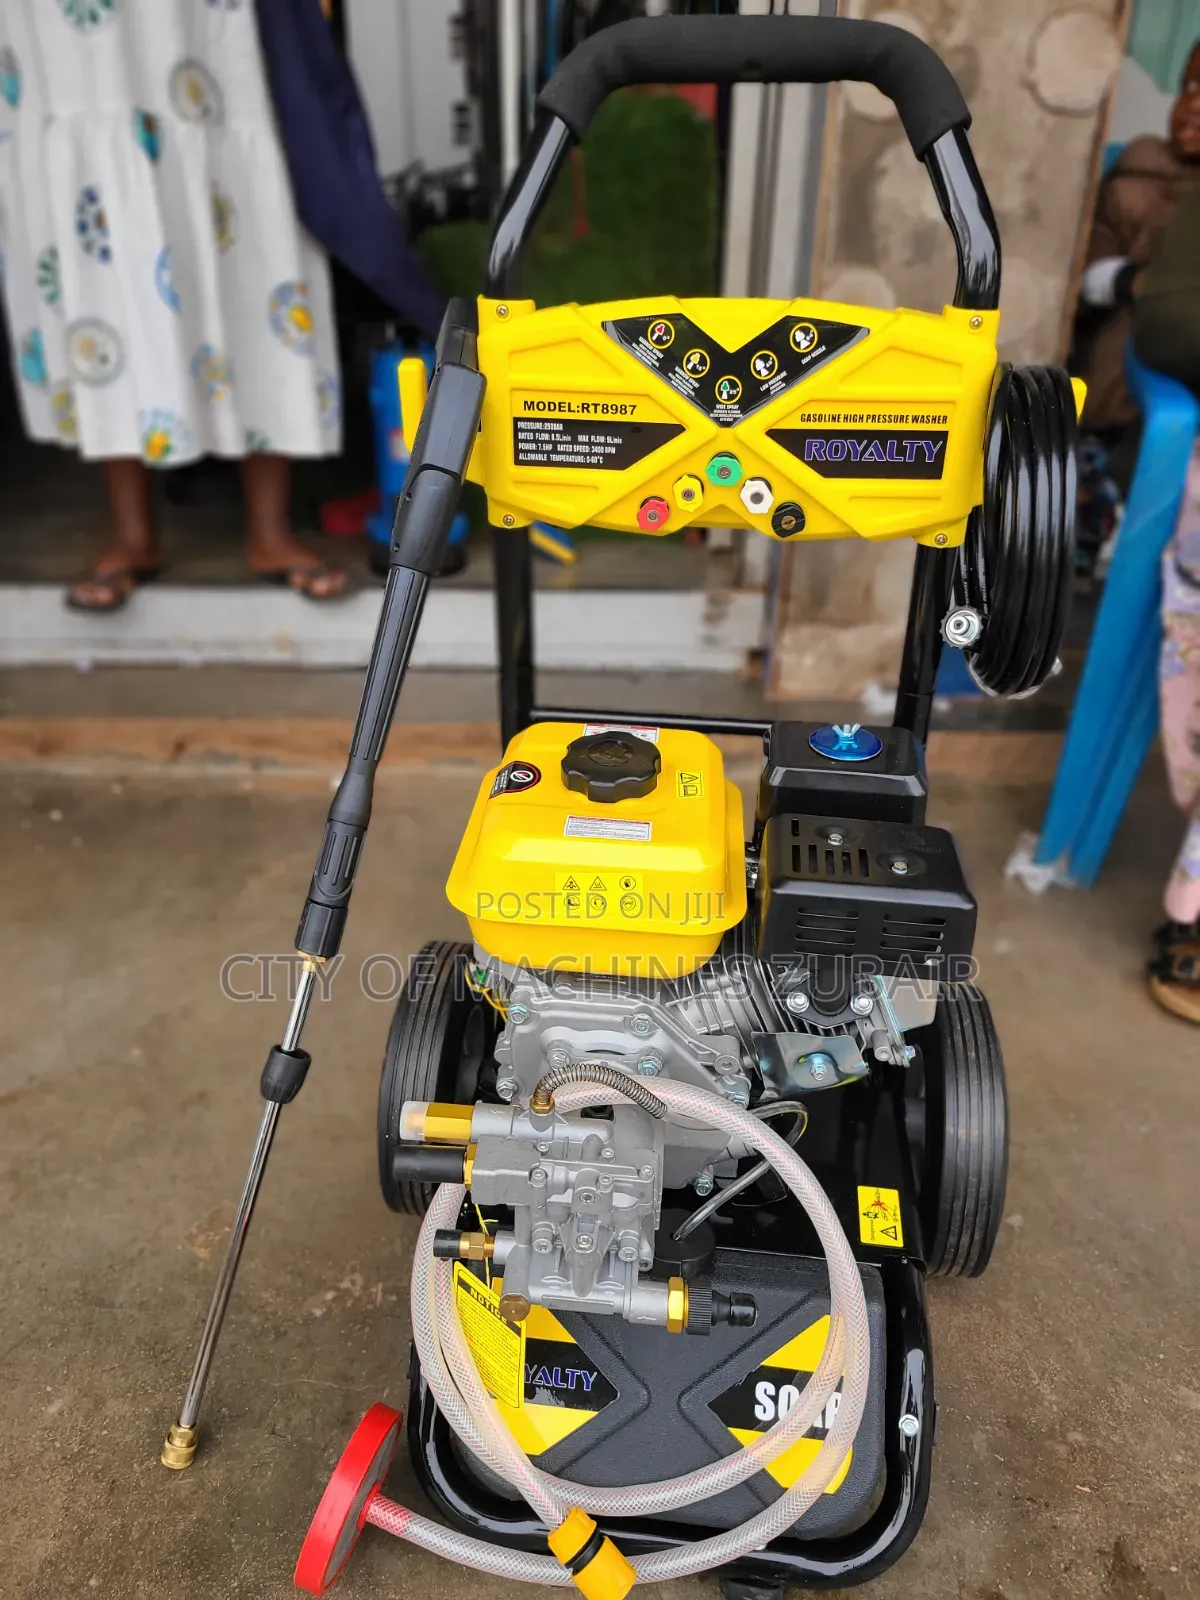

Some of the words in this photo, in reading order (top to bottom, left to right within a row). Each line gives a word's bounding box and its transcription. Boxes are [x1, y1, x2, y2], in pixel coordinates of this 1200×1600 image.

[523, 400, 637, 416] MODEL:RT8987
[800, 413, 842, 423] GASOLINE
[843, 414, 864, 423] HIGH
[866, 414, 910, 424] PRESSURE
[911, 415, 948, 424] WASHER
[518, 432, 534, 440] RATED
[535, 433, 551, 441] FLOW:
[577, 434, 589, 442] MAX
[518, 443, 538, 451] POWER:
[557, 444, 573, 452] RATED
[573, 445, 591, 453] SPEED:
[804, 439, 943, 462] ROYALTY
[519, 453, 547, 461] ALLOWABLE
[550, 454, 586, 463] TEMPERATURE:
[470, 1287, 508, 1325] NOTICE
[754, 1381, 842, 1429] SOP
